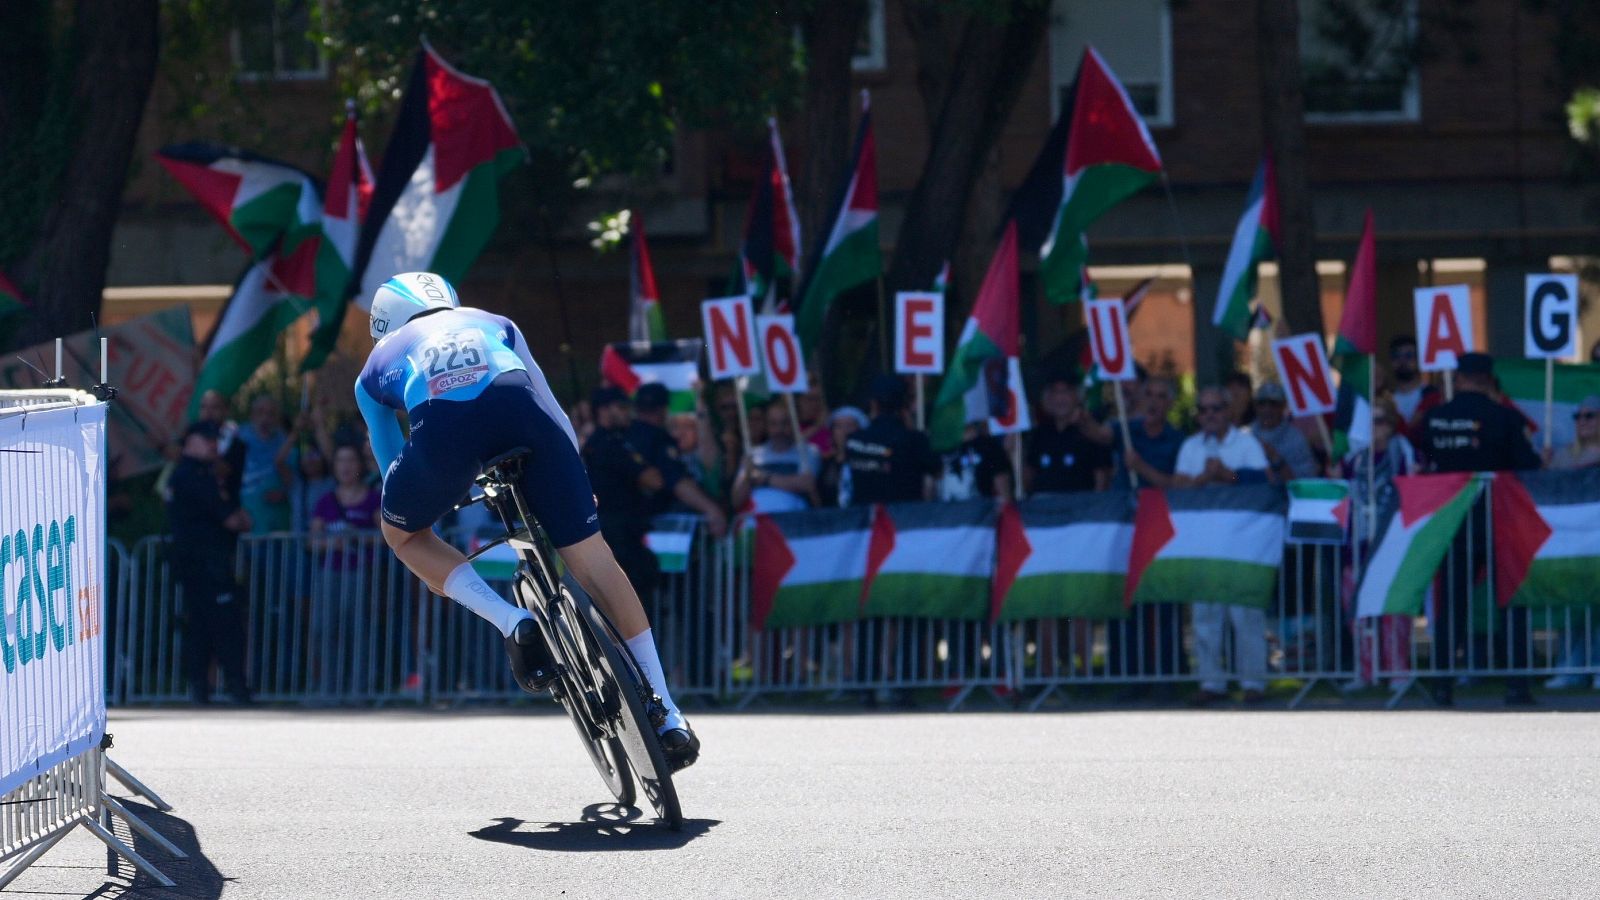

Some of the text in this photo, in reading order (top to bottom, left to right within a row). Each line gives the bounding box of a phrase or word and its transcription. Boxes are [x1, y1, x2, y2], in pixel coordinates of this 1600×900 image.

[904, 299, 933, 366] E
[1090, 305, 1126, 374] U
[1424, 293, 1467, 364] A
[1530, 280, 1571, 352] G
[378, 368, 404, 389] FACTOR
[424, 342, 481, 378] 225
[1278, 339, 1331, 410] N
[0, 514, 76, 675] caser
